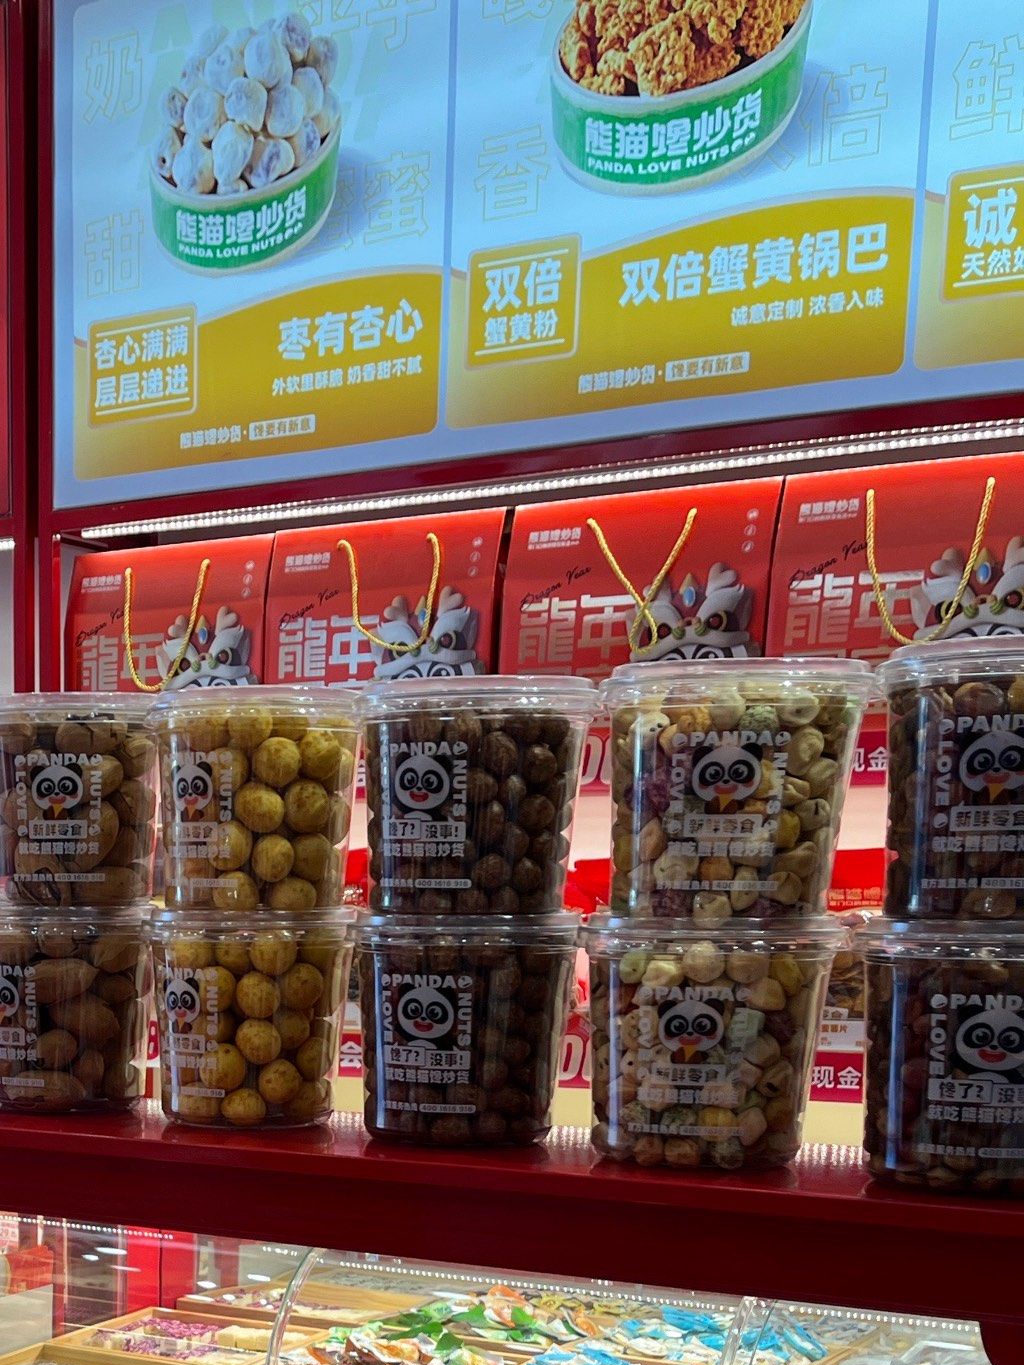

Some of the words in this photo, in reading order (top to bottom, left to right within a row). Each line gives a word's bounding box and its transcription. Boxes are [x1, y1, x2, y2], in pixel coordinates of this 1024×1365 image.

[585, 88, 763, 160] 熊猫馋炒货
[588, 157, 634, 175] PANDA
[638, 157, 682, 175] LOVE
[685, 146, 729, 168] NUTS
[176, 185, 307, 247] 熊猫馋炒货
[178, 244, 214, 258] PANDA
[216, 243, 250, 258] LOVE
[618, 222, 888, 306] 双倍蟹黄锅巴
[482, 258, 563, 312] 双倍
[95, 325, 188, 370] 杏心满满
[278, 299, 423, 360] 枣有杏心
[484, 309, 559, 346] 蟹黄粉
[95, 364, 188, 407] 层层递进
[26, 753, 87, 767] PANDA
[389, 742, 450, 757] PANDA
[690, 731, 773, 747] PANDA
[453, 760, 468, 818] NUTS
[936, 740, 955, 807] LOVE
[89, 770, 103, 823] NUTS
[393, 973, 456, 989] PANDA
[457, 992, 473, 1047] NUTS
[929, 1014, 947, 1076] LOVE
[812, 1065, 862, 1089] 现金
[939, 1081, 984, 1098] 馋了?
